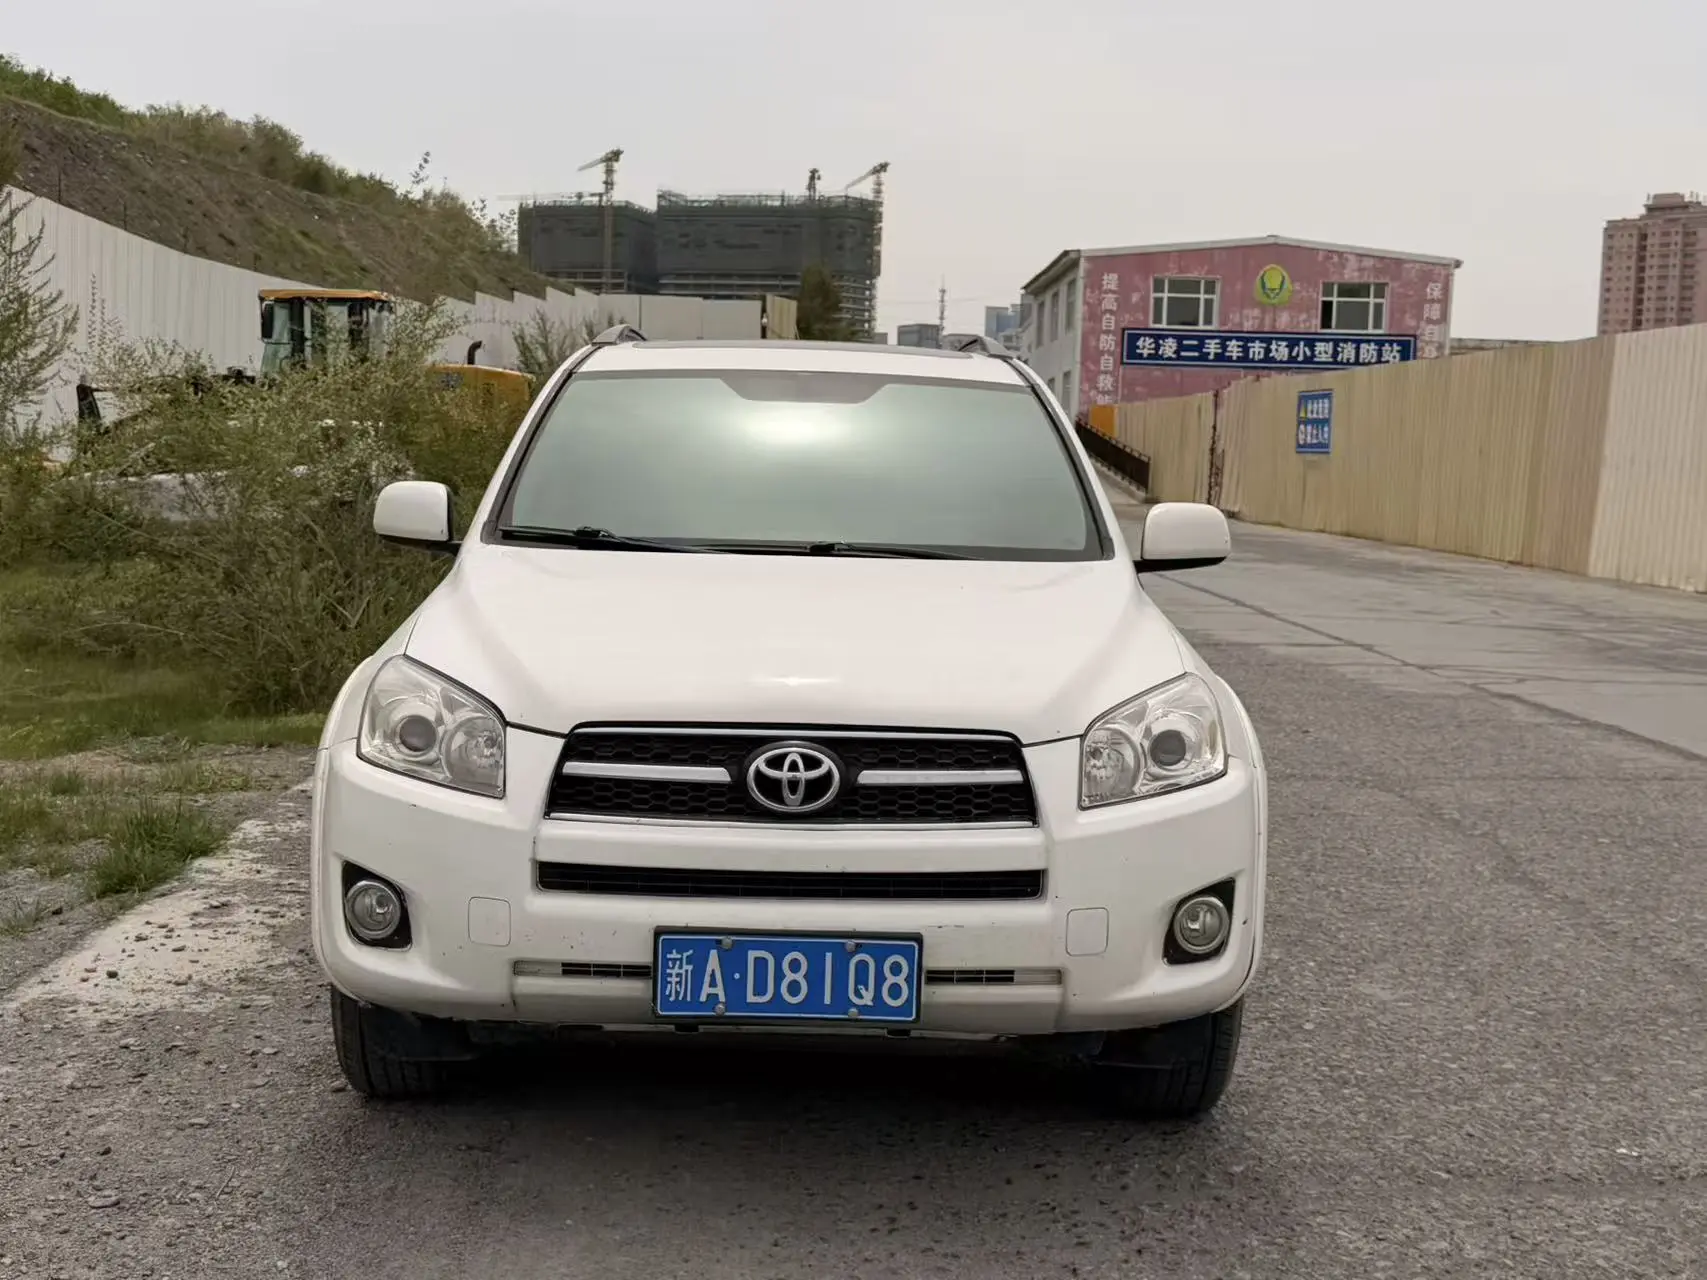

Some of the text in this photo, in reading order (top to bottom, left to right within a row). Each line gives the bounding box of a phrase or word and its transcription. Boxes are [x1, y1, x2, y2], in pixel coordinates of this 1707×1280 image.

[1135, 336, 1402, 363] 华凌二手车市场小型消防站
